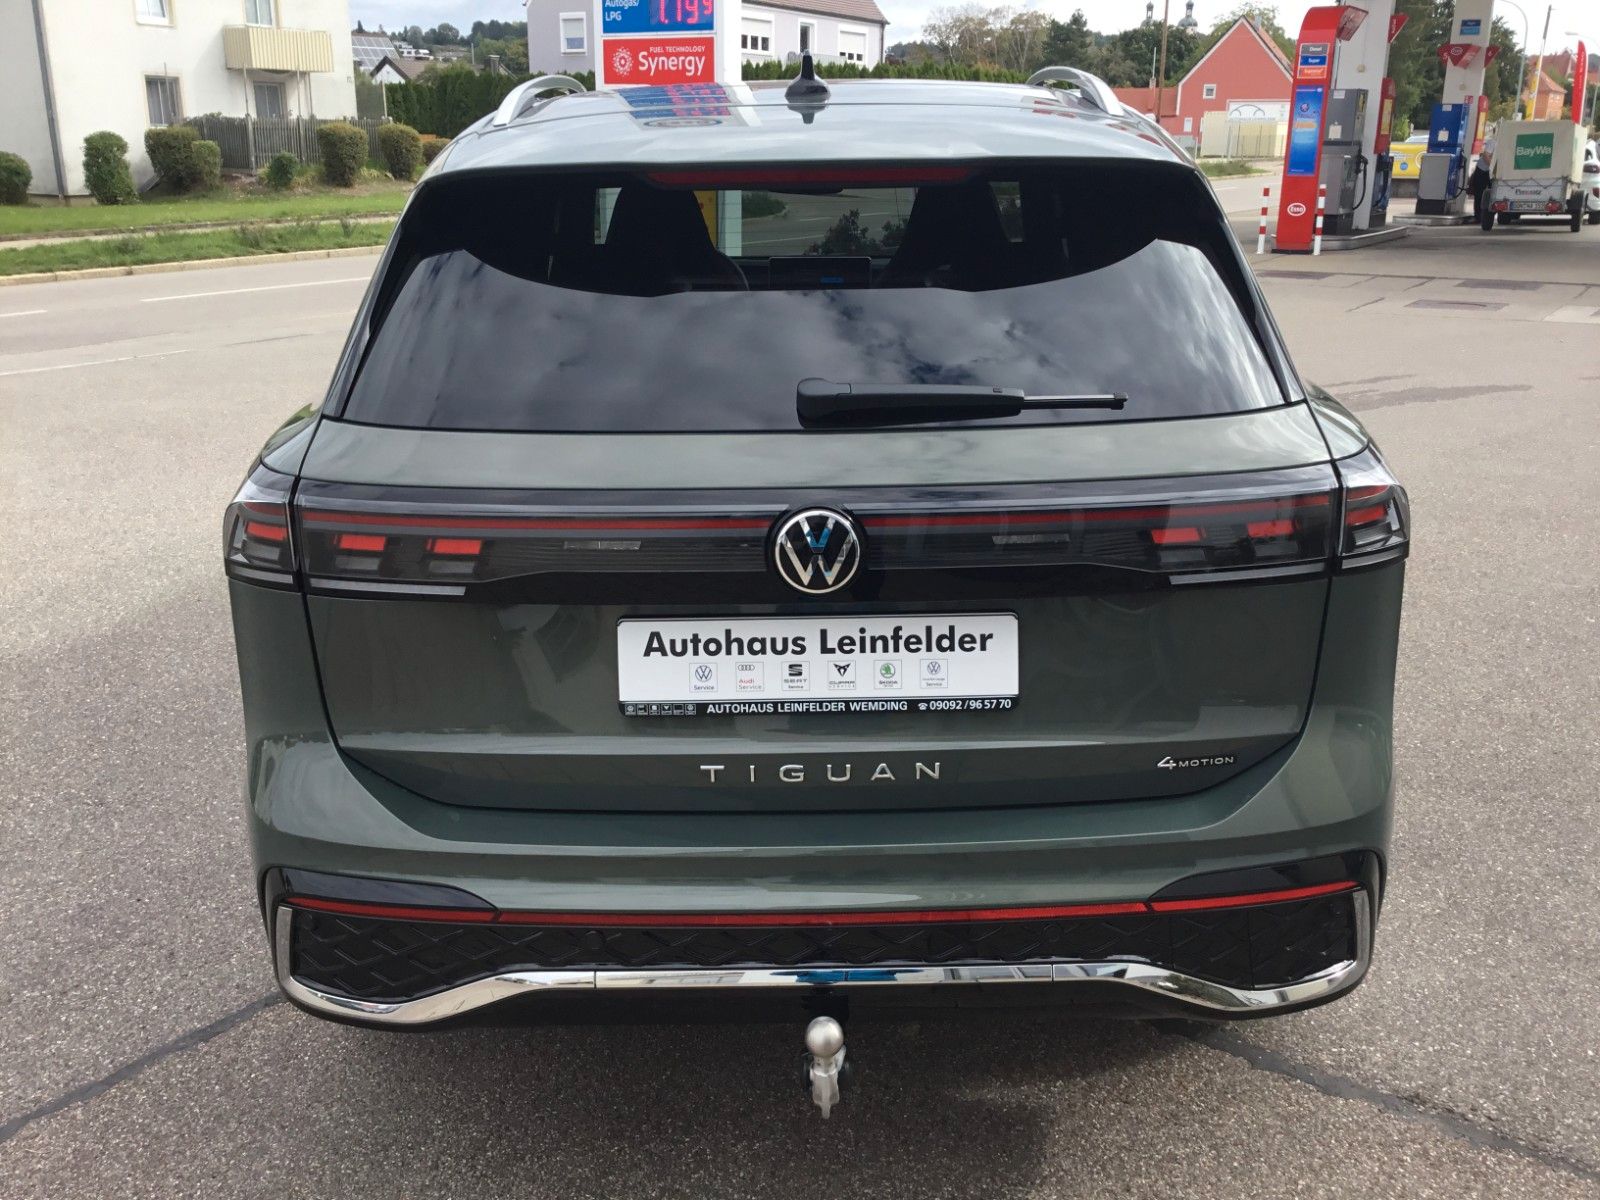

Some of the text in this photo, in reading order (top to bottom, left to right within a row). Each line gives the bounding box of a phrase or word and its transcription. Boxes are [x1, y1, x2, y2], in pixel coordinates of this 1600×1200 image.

[605, 11, 622, 21] LPG
[638, 50, 705, 76] Synergy
[1516, 145, 1552, 157] BayWa
[643, 625, 994, 657] Autohaus Leinfelder
[706, 703, 774, 714] AUTOHAUS
[777, 702, 846, 713] LEINFELDER
[849, 701, 908, 711] WEMDING
[699, 762, 941, 783] TIGUAN
